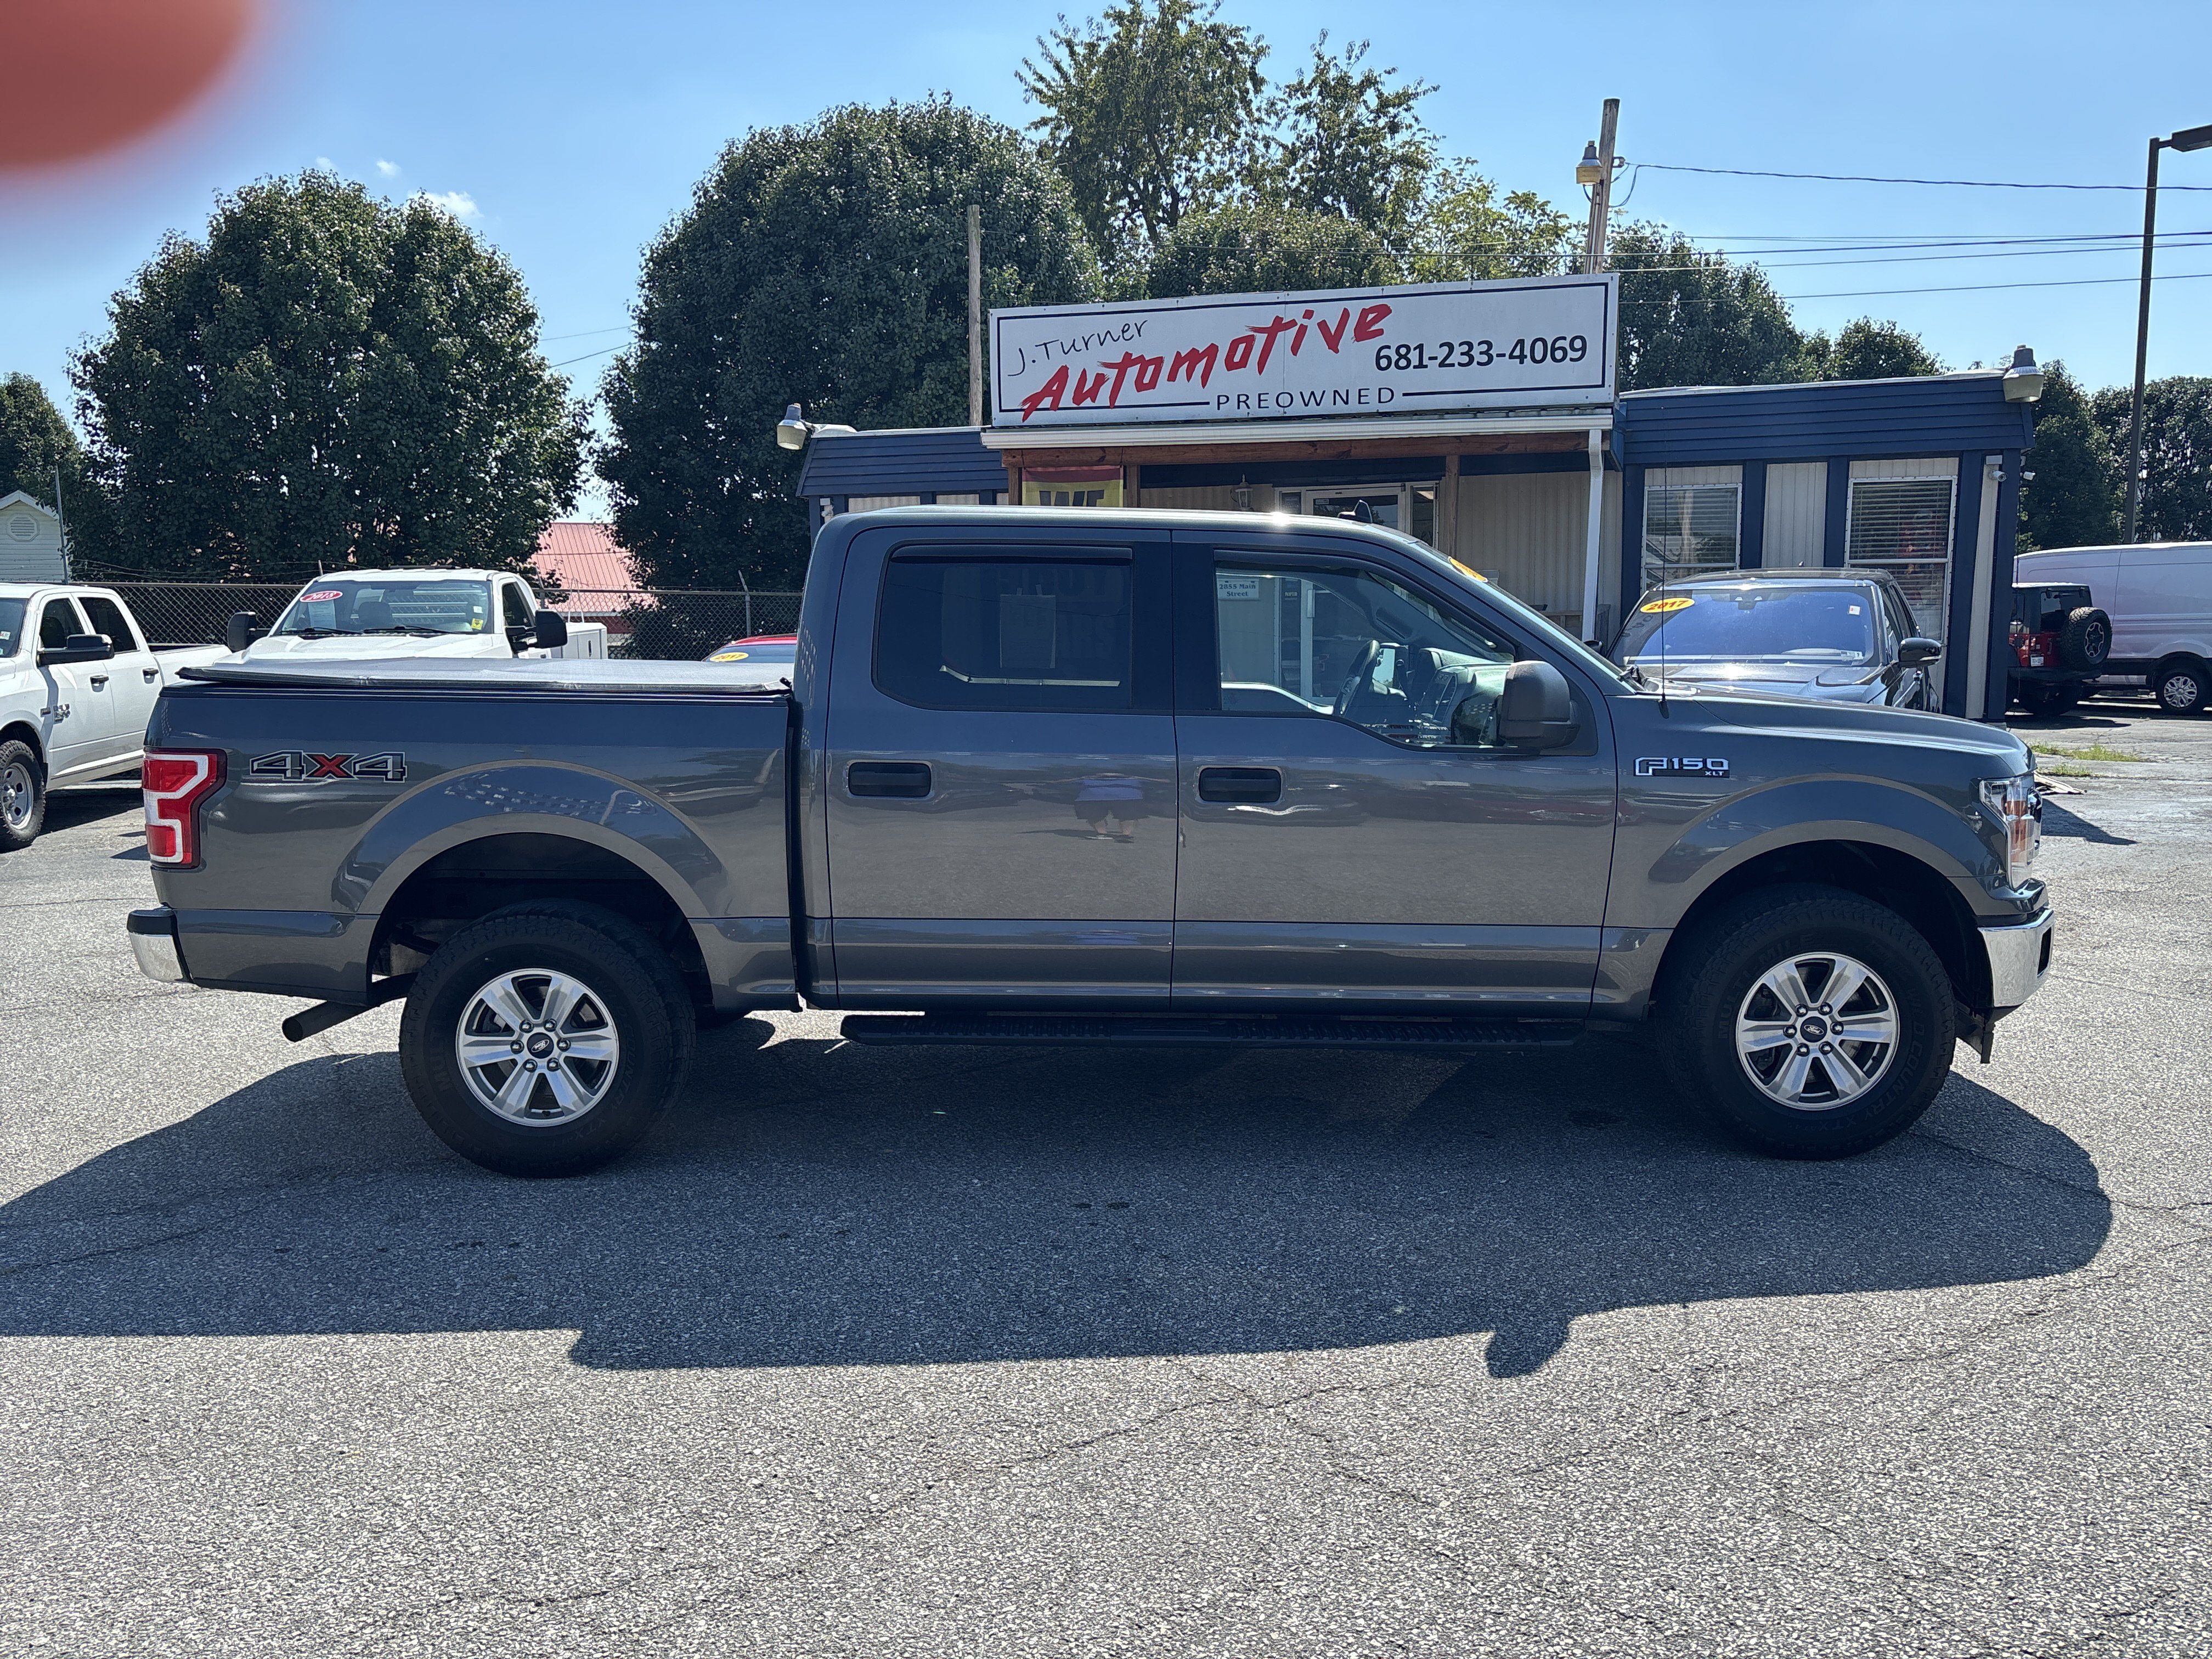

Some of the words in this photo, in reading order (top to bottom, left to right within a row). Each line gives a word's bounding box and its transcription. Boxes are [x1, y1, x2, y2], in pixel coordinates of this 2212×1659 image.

[1018, 304, 1392, 422] Automotive
[1375, 335, 1587, 371] 681-233-4069
[1217, 387, 1395, 410] PREOWNED
[1646, 600, 1689, 611] 2017
